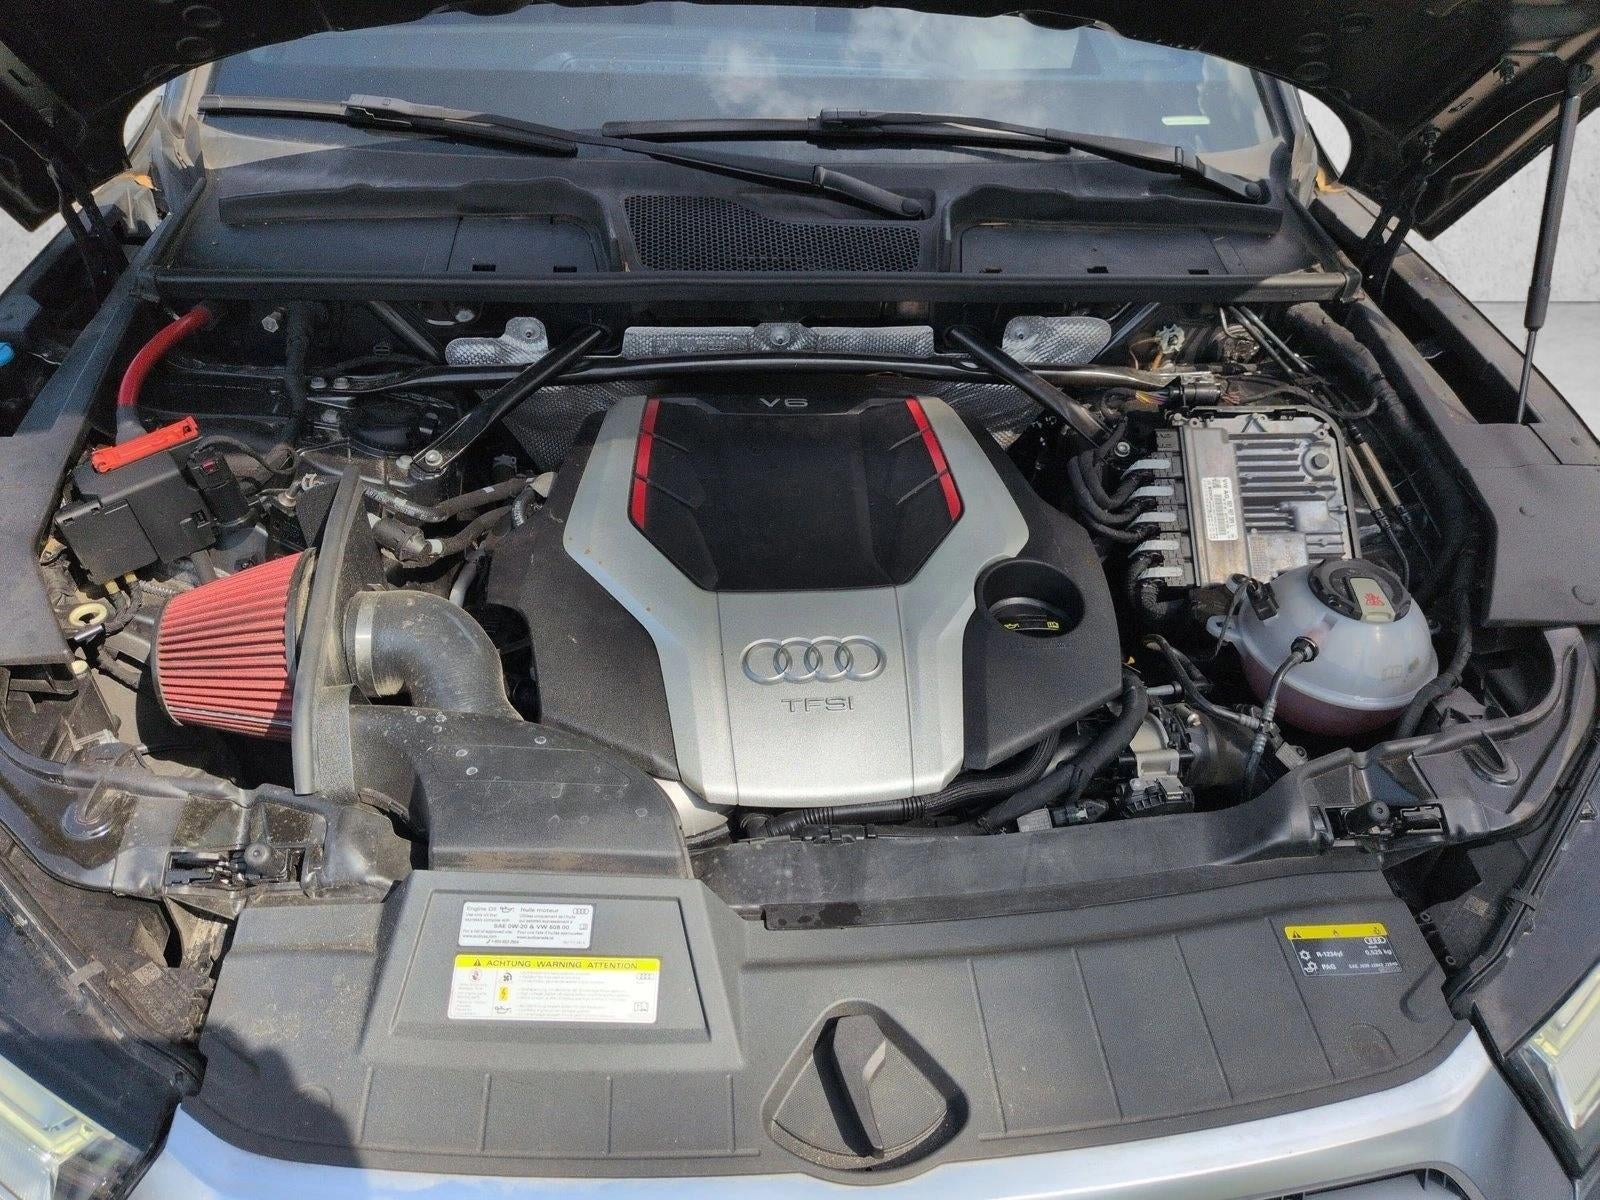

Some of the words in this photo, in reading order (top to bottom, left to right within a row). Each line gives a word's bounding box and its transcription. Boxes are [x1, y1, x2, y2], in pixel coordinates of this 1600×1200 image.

[759, 397, 809, 408] V6
[781, 696, 855, 713] TFSI
[486, 960, 531, 968] ACHTUNG
[536, 960, 582, 969] WARNING
[587, 961, 638, 970] ATTENTION
